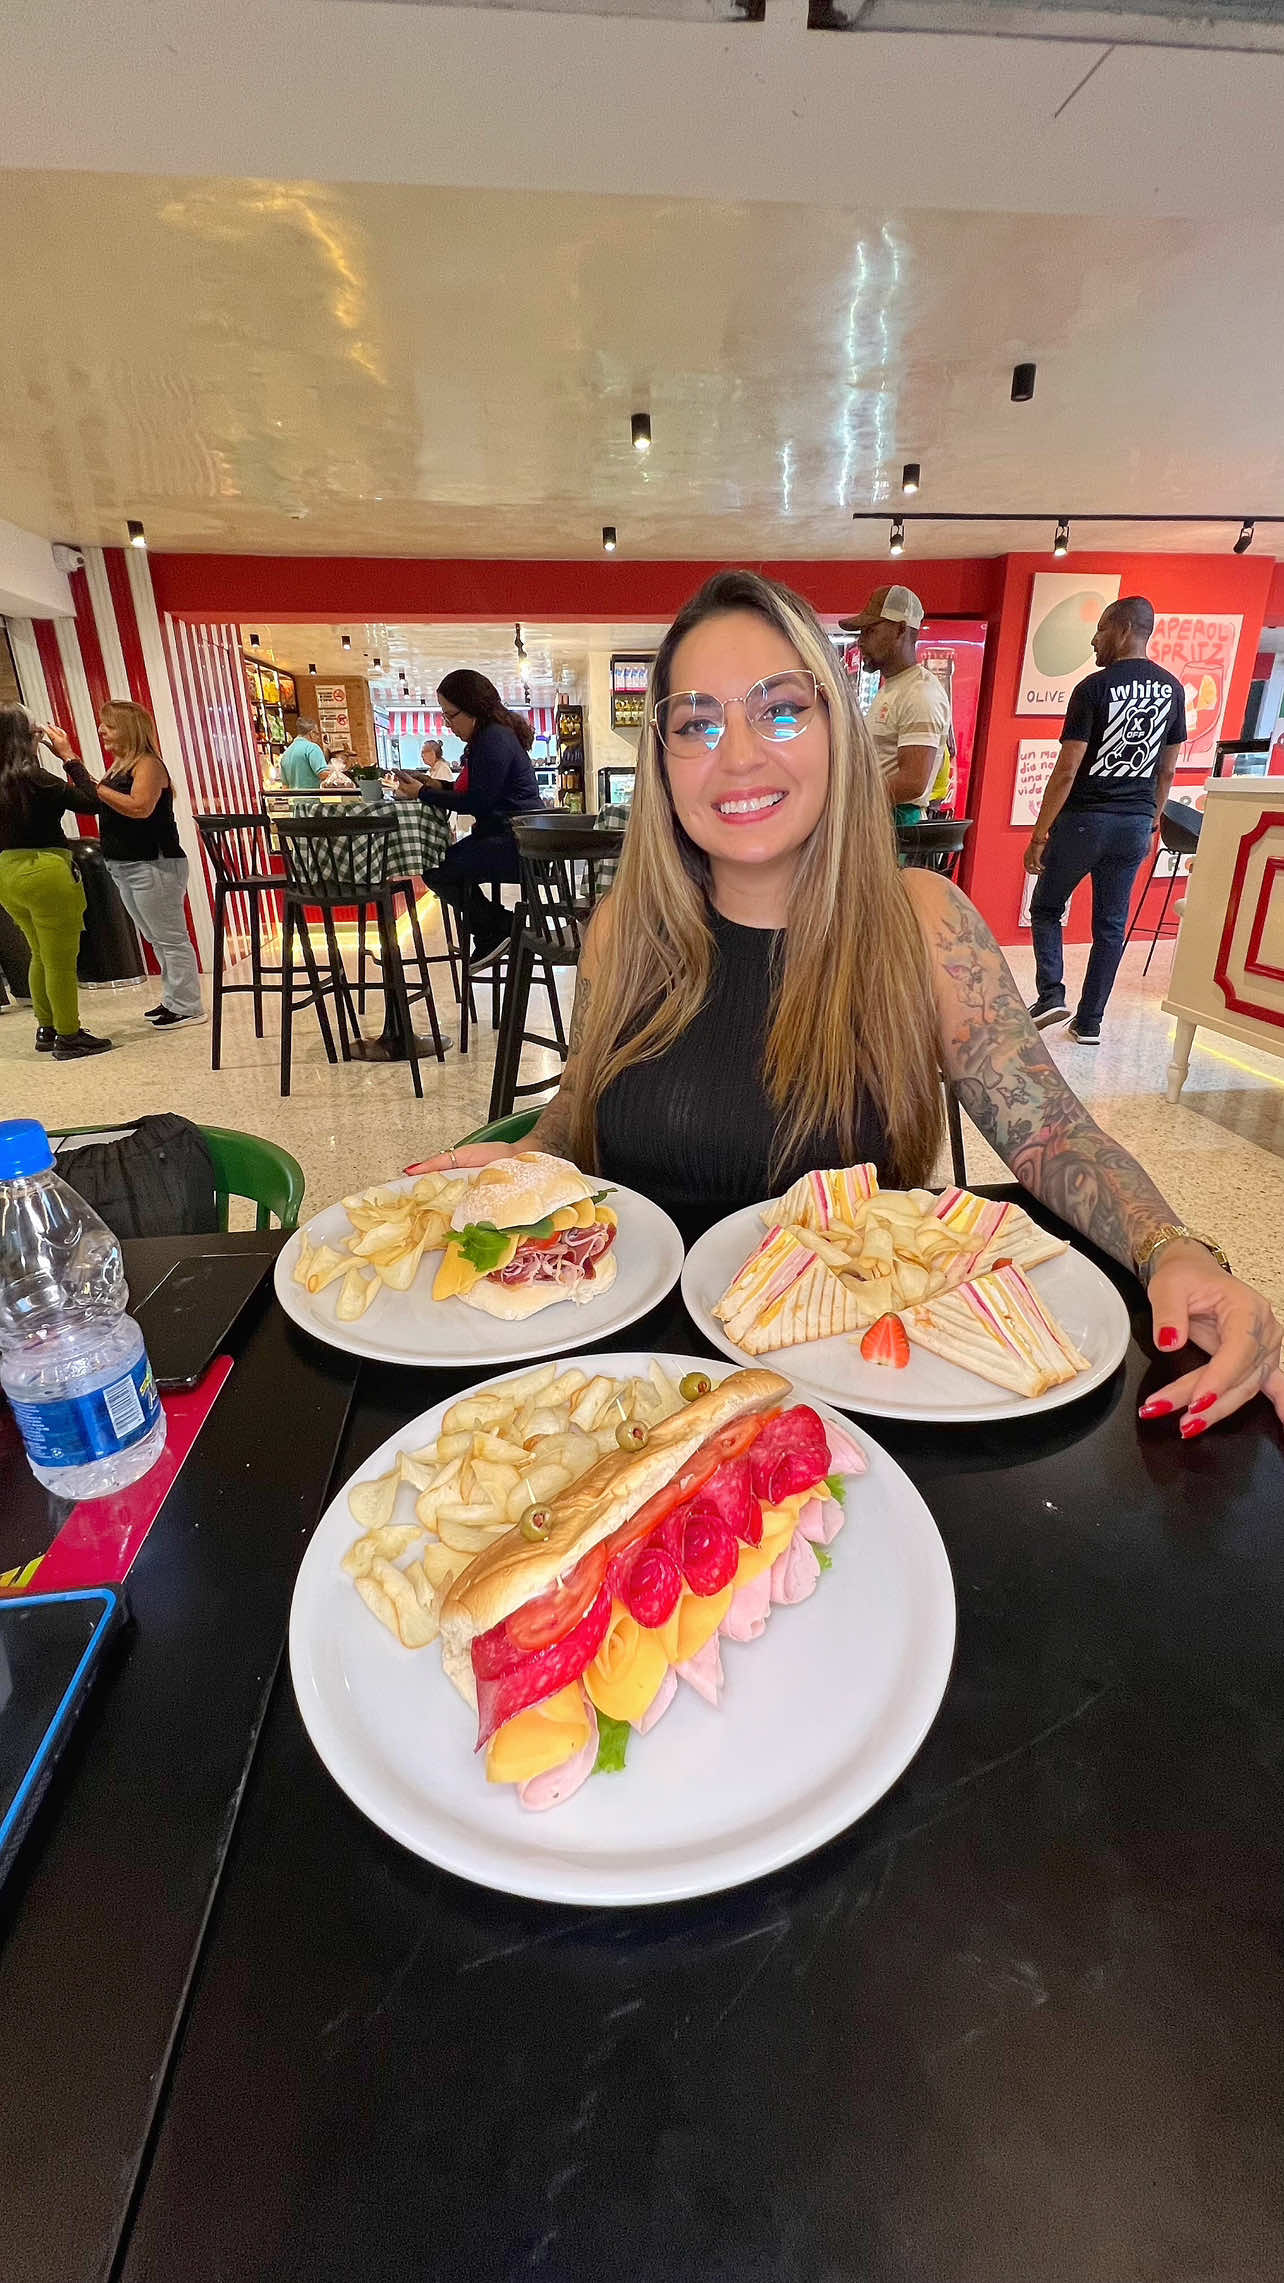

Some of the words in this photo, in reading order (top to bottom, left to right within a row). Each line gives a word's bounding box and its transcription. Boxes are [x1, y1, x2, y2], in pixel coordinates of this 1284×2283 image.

[1153, 617, 1229, 642] APEROL
[1151, 640, 1225, 665] SPRITZ
[1027, 690, 1065, 703] OLIVE
[1131, 718, 1145, 731] X
[1126, 731, 1145, 739] OFF
[1020, 752, 1036, 760] un
[1020, 762, 1037, 774] dia
[1021, 774, 1042, 783] una
[1018, 782, 1043, 796] vida
